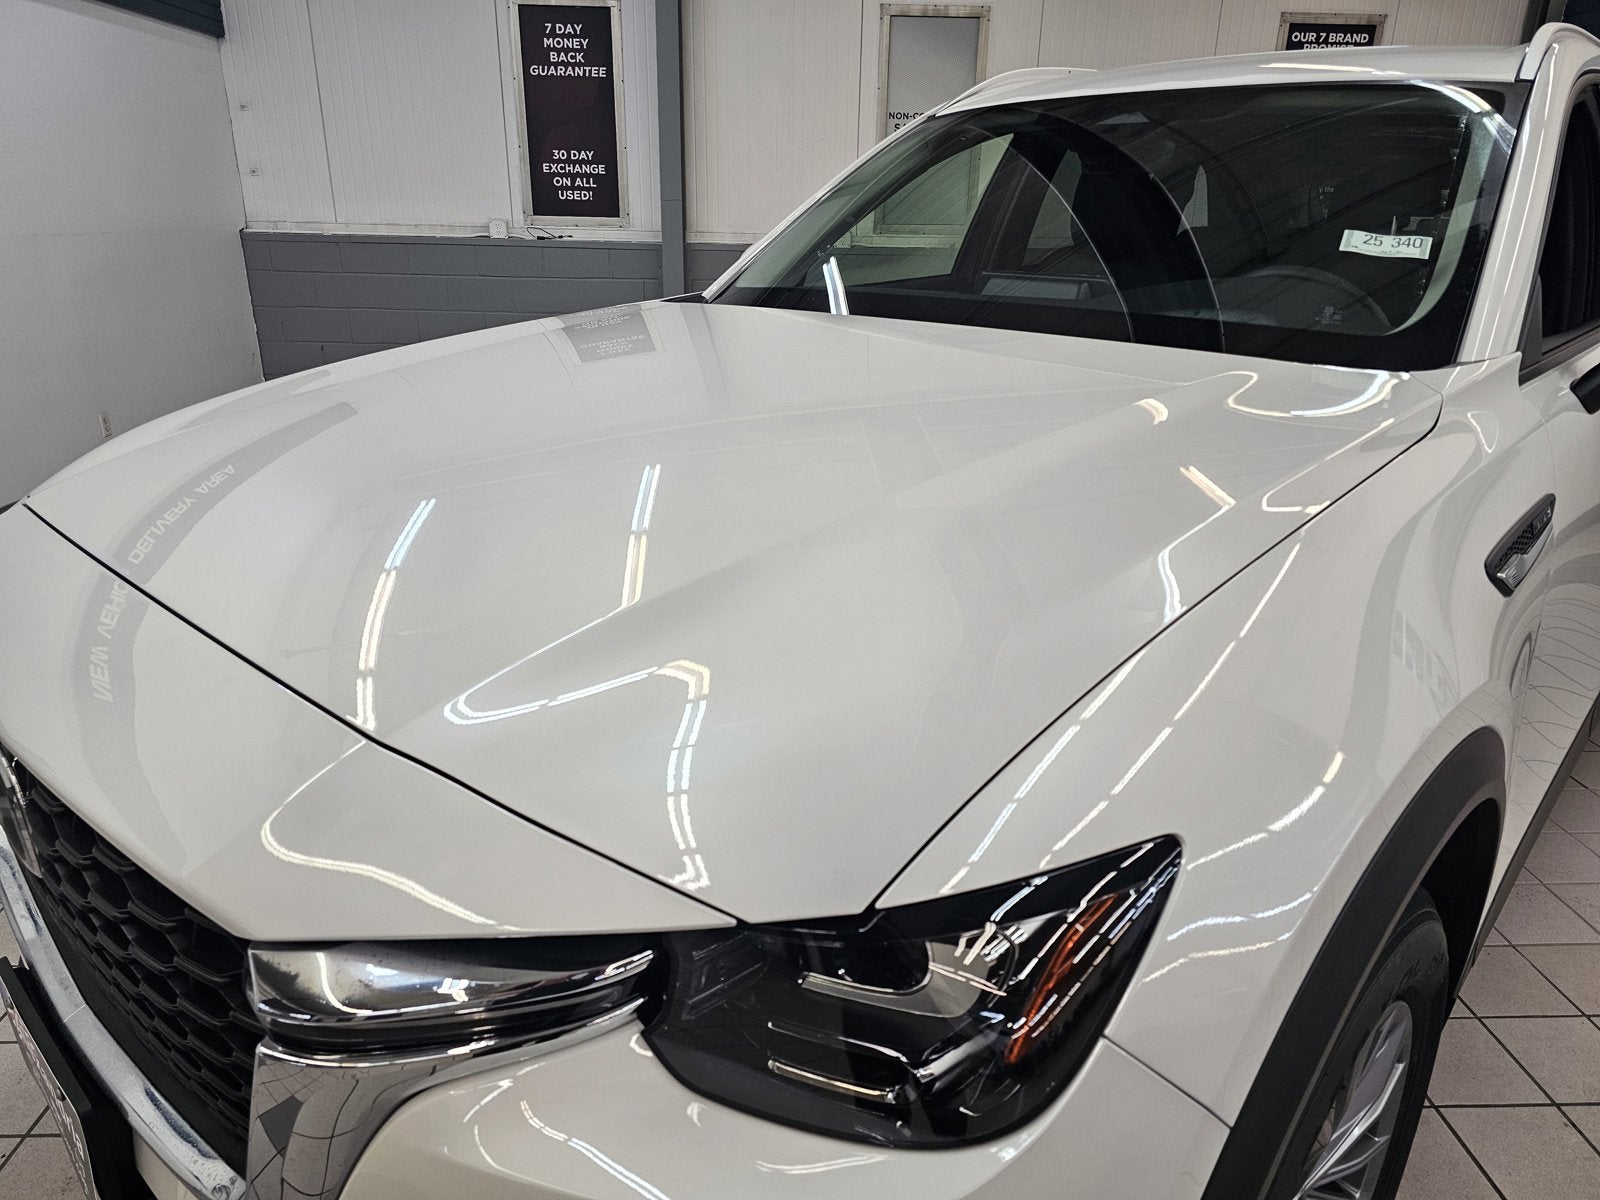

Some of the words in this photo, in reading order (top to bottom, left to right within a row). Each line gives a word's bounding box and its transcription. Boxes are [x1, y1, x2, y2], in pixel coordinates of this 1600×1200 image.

[544, 24, 552, 34] 7
[556, 24, 582, 35] DAY
[1292, 32, 1316, 42] OUR
[1319, 33, 1326, 42] 7
[1328, 33, 1369, 43] BRAND
[544, 38, 589, 49] MONEY
[550, 52, 584, 62] BACK
[530, 66, 606, 77] GUARANTEE
[552, 150, 567, 160] 30
[571, 150, 594, 160] DAY
[542, 164, 606, 174] EXCHANGE
[553, 177, 571, 187] ON
[574, 178, 597, 188] ALL
[558, 190, 594, 200] USED!
[1362, 234, 1383, 246] 25
[1391, 237, 1424, 248] 340
